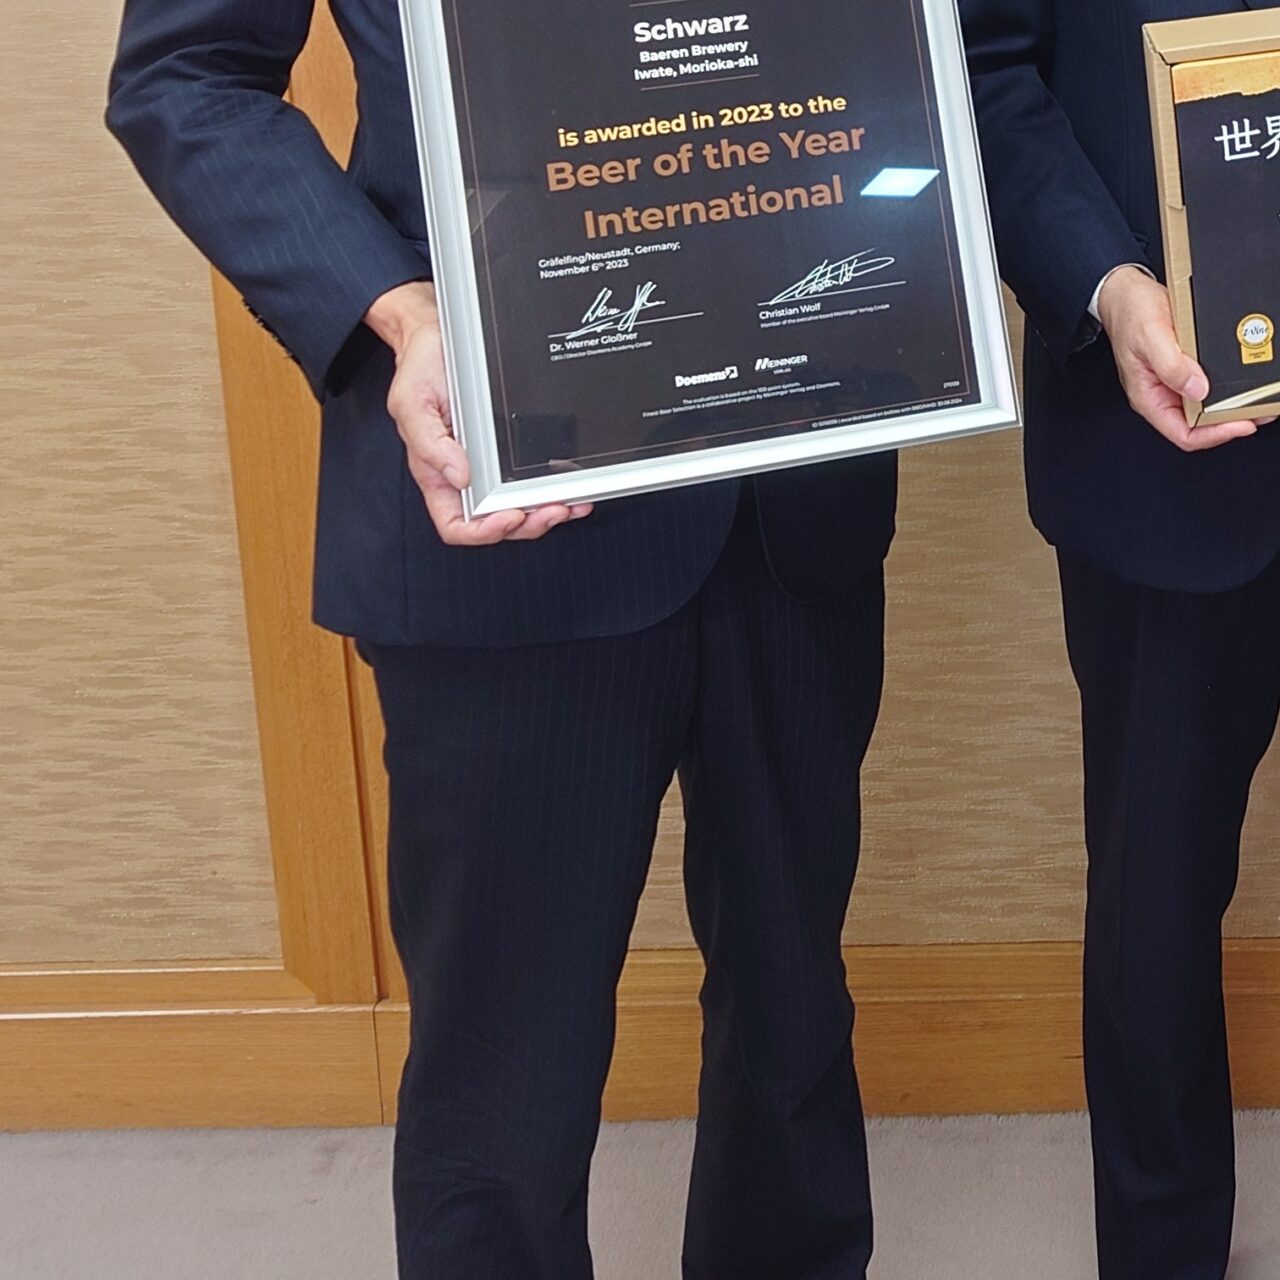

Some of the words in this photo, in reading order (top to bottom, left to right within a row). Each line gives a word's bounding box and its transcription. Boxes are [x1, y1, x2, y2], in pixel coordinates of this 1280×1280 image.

[633, 14, 749, 43] Schwarz
[639, 47, 689, 63] Baeren
[691, 41, 748, 57] Brewery
[634, 67, 678, 81] Iwate,
[679, 53, 759, 75] Morioka-shi
[557, 128, 579, 148] is
[583, 113, 686, 146] awarded
[691, 111, 714, 130] in
[718, 103, 774, 126] 2023
[778, 101, 803, 119] to
[807, 95, 847, 115] the
[546, 155, 642, 192] Beer
[653, 143, 694, 177] of
[702, 138, 771, 171] the
[778, 127, 866, 160] Year
[583, 174, 844, 240] International
[540, 264, 591, 279] November
[606, 258, 629, 270] 2023
[759, 307, 799, 320] Christian
[799, 302, 822, 314] Wolf
[549, 342, 564, 353] Dr.
[565, 338, 599, 350] Werner
[600, 332, 638, 345] Gloßner
[755, 355, 808, 371] MEININGER
[674, 371, 727, 388] Doemens
